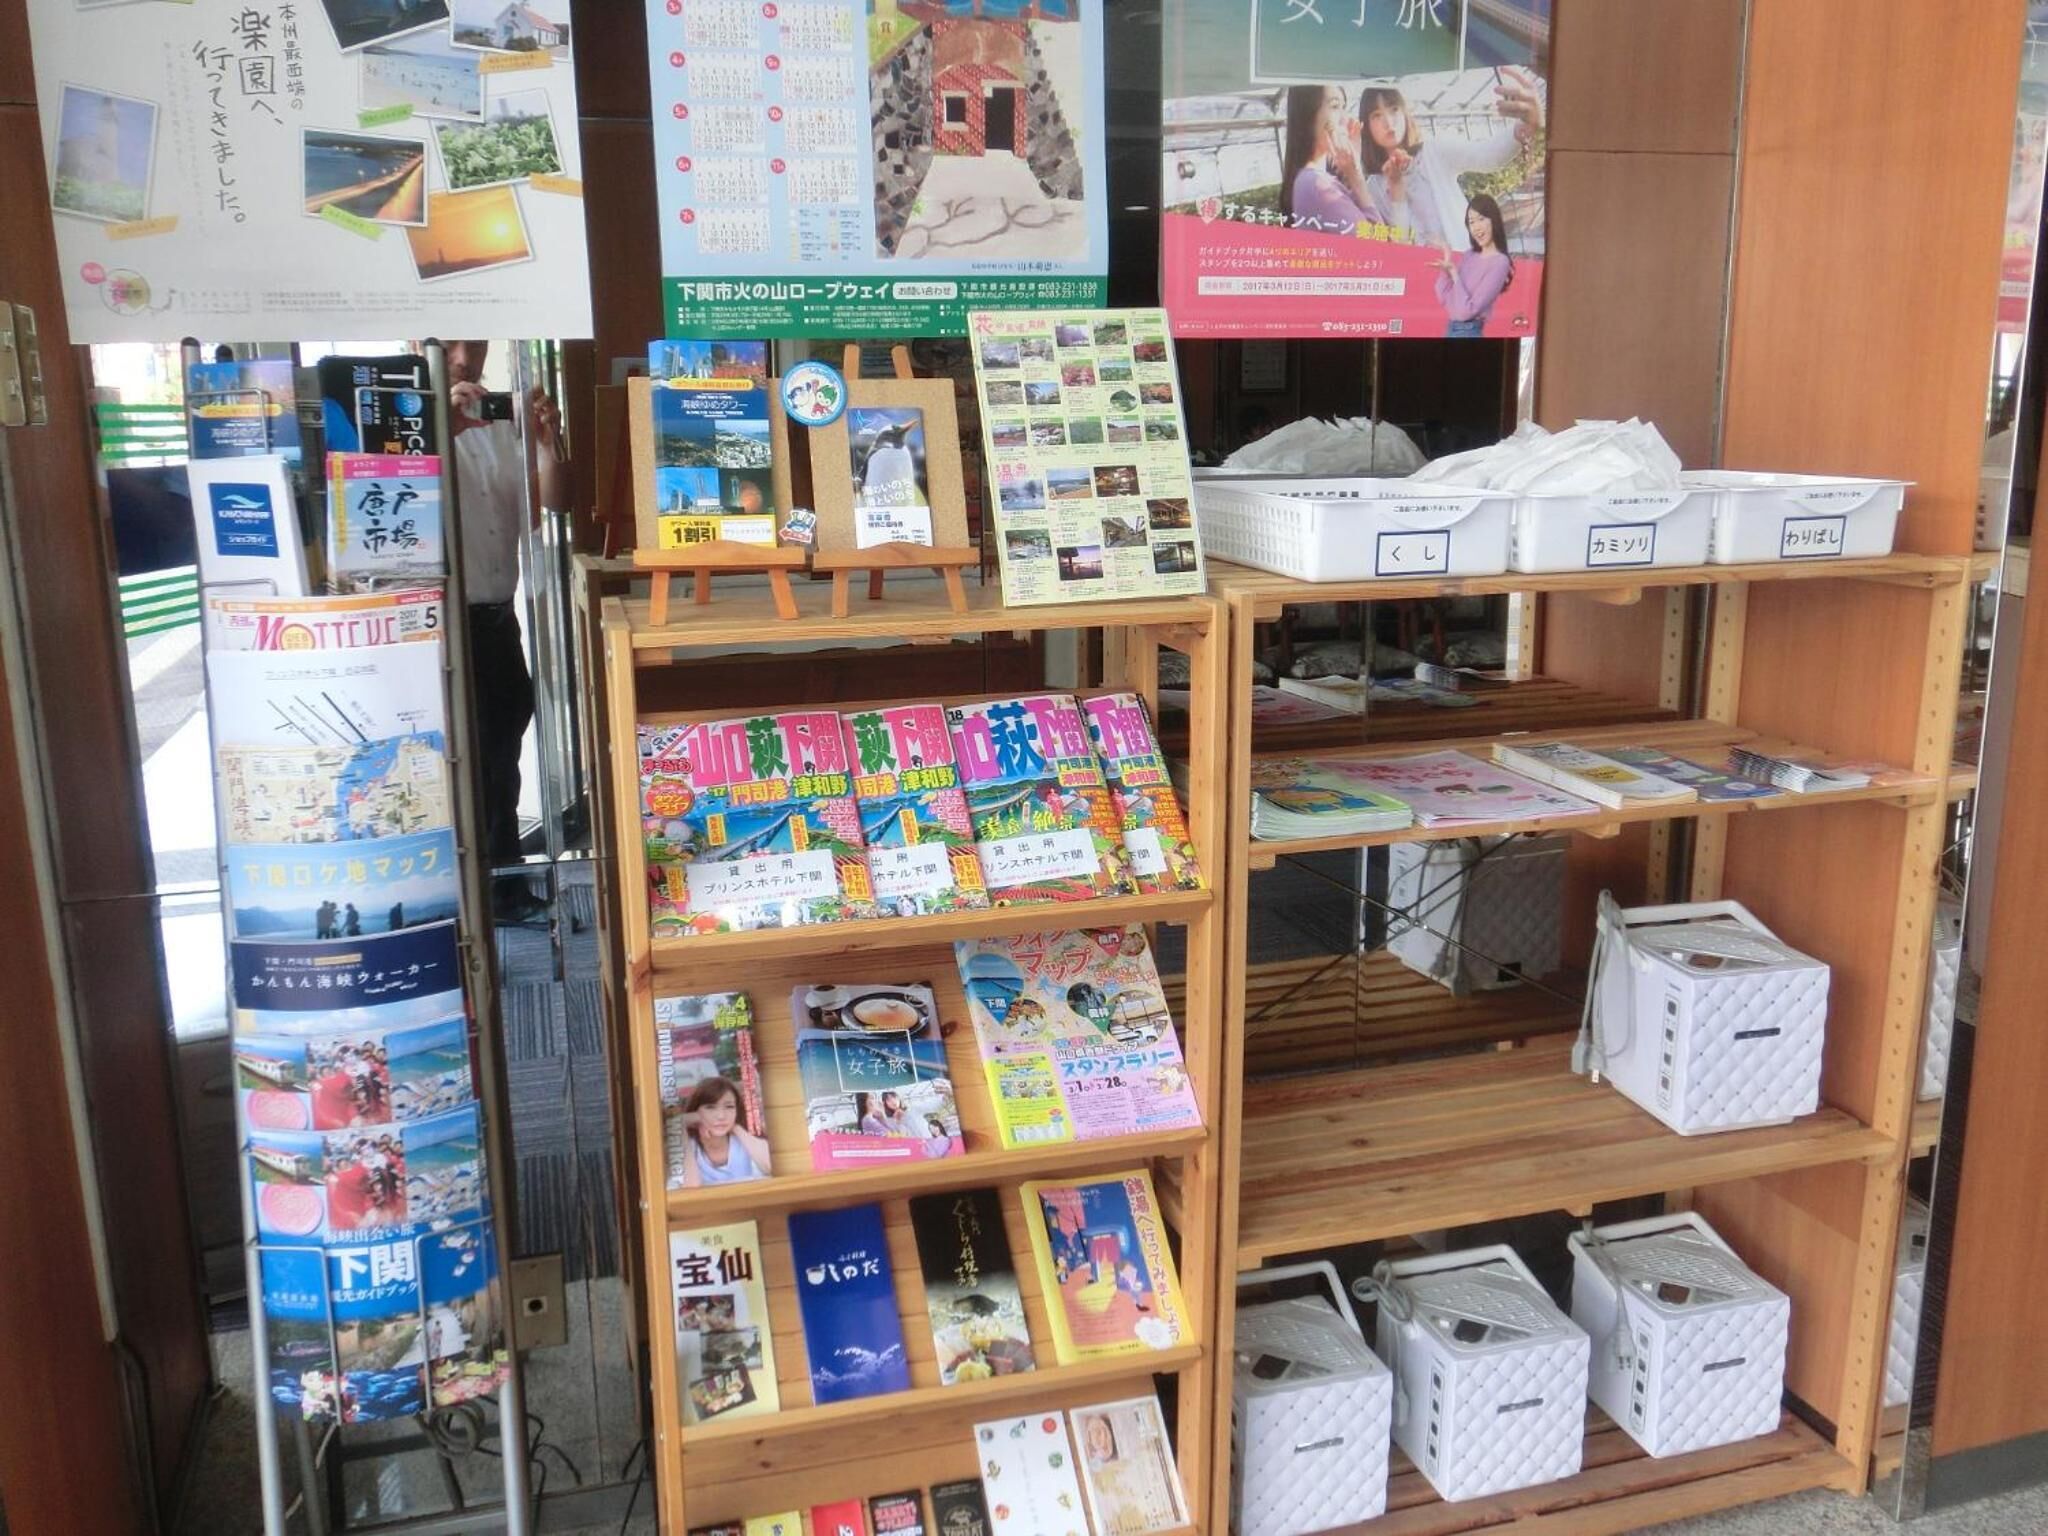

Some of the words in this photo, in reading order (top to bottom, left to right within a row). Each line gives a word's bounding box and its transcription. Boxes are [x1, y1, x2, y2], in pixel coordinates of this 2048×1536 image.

[231, 7, 283, 124] 楽園へ、
[278, 4, 305, 110] 本州最西端の
[192, 40, 246, 223] 行ってきました。
[678, 281, 889, 301] 下関市火の山ロープウェイ
[1593, 537, 1649, 554] カミソリ
[1786, 528, 1840, 547] わりばし
[425, 606, 438, 629] 5
[244, 848, 439, 887] 下関ロケ地マップ
[704, 871, 823, 895] プリンスホテル下関
[252, 963, 438, 990] かんもん海峡ウォーカー
[1010, 947, 1093, 985] マップ
[848, 1057, 908, 1076] 女子旅
[325, 1239, 415, 1289] 下関
[676, 1247, 753, 1289] 宝仙
